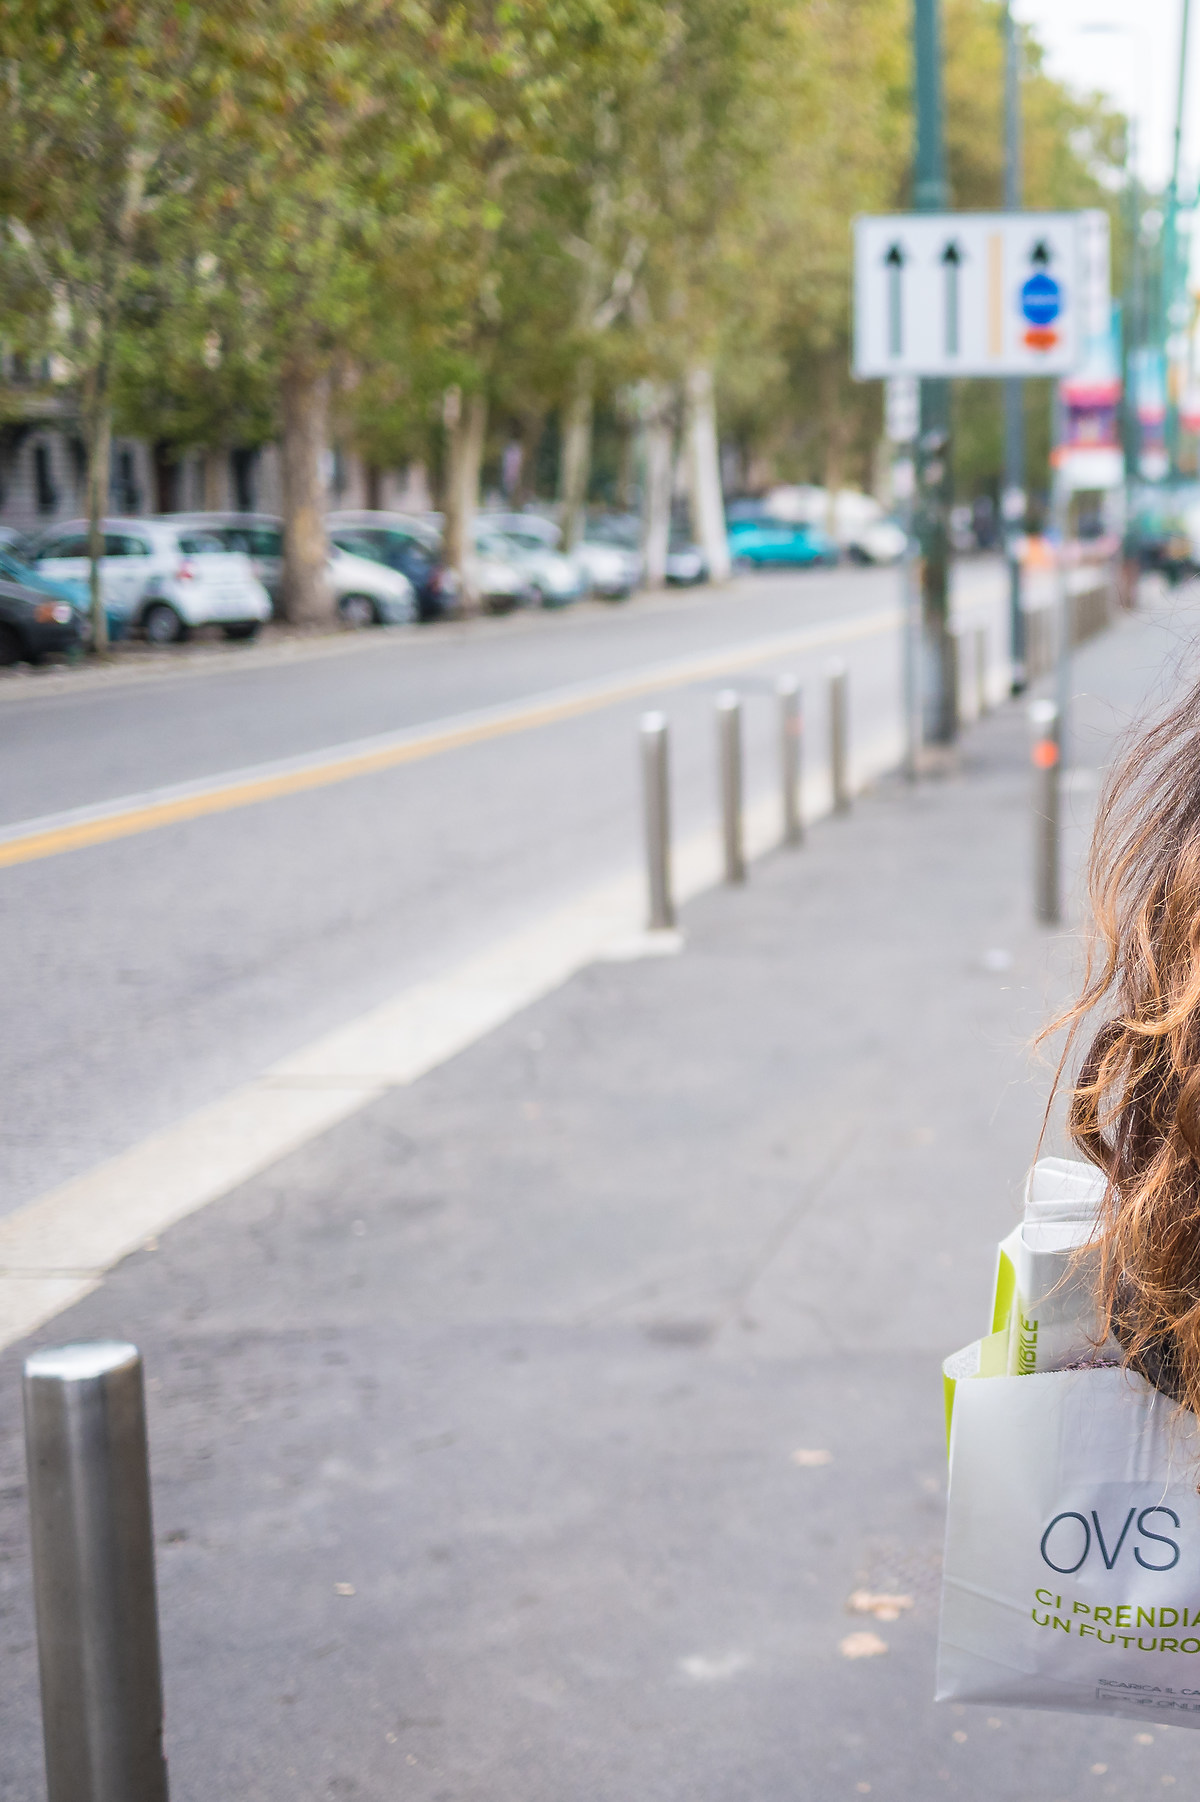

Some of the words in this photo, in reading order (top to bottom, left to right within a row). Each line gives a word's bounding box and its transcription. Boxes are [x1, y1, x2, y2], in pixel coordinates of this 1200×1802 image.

[1041, 1506, 1181, 1573] OVS
[1035, 1588, 1062, 1609] CI
[1032, 1608, 1071, 1633] UN
[1098, 1679, 1161, 1692] SCARICA
